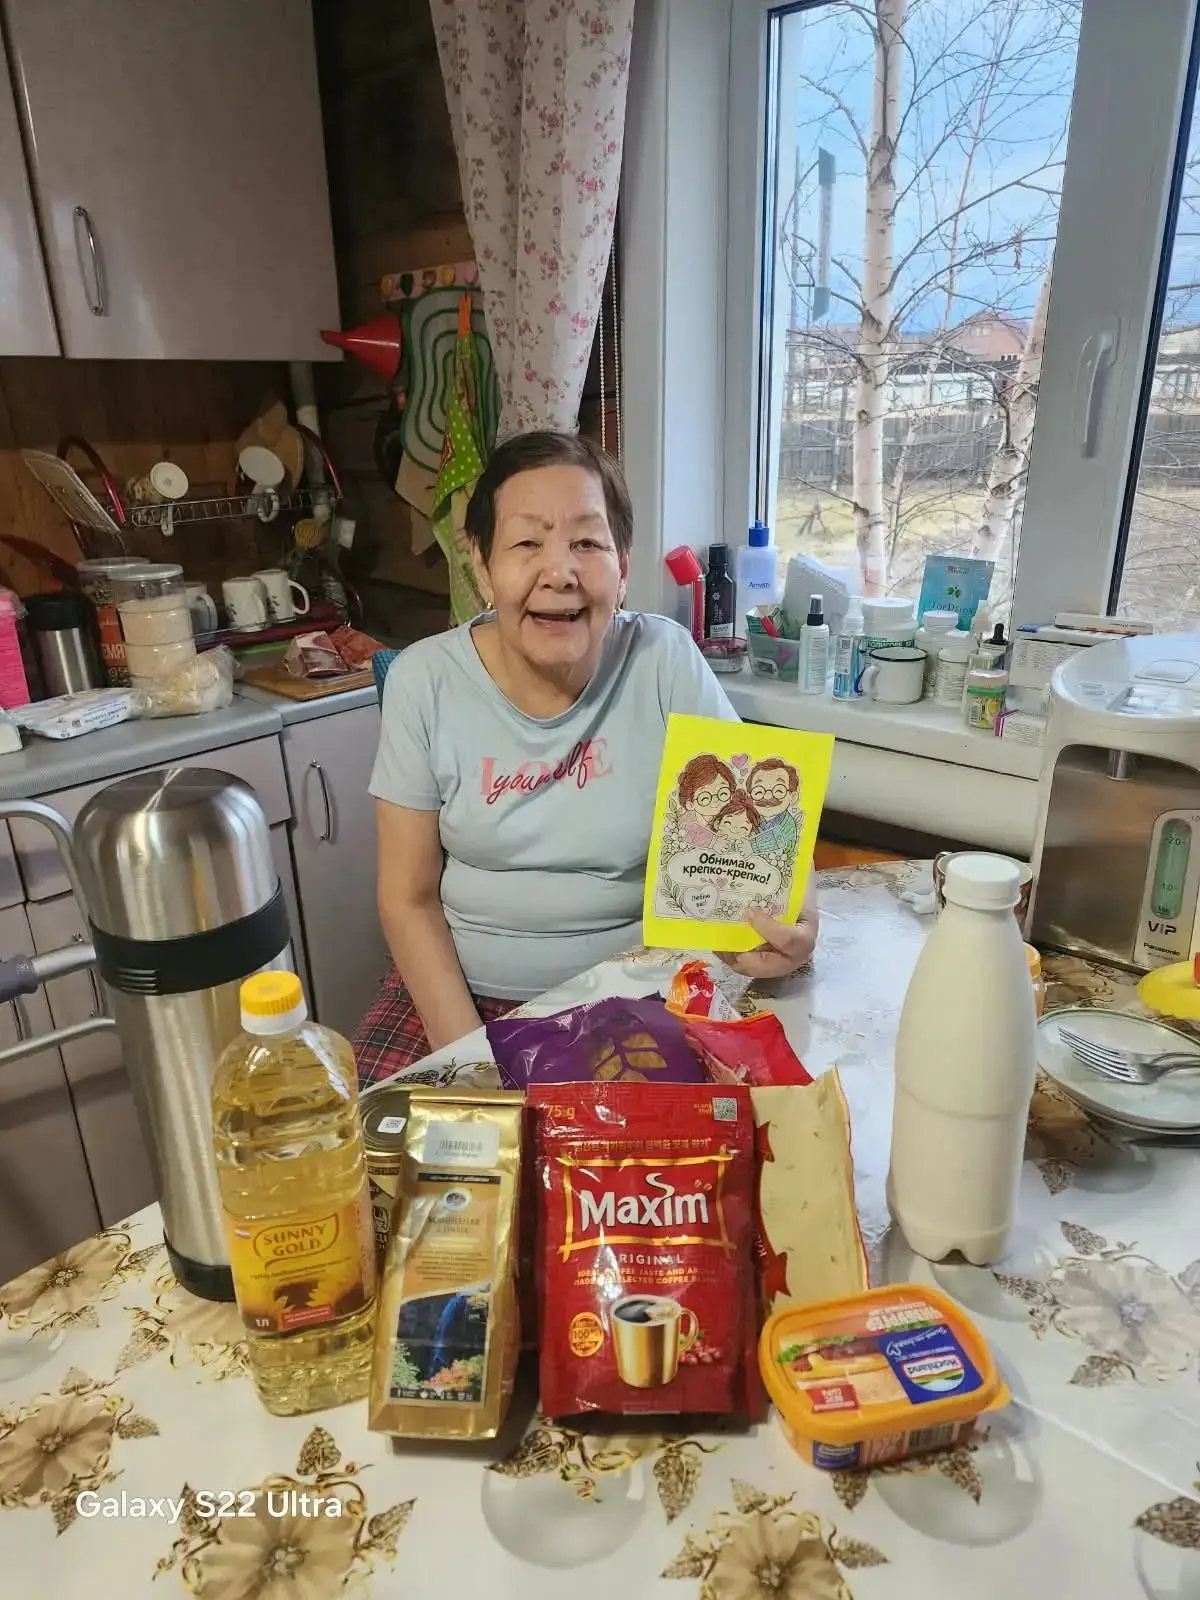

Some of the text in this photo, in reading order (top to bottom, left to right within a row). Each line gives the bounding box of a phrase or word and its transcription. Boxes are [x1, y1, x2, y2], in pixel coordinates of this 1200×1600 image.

[699, 852, 755, 871] Обнимаю
[683, 865, 771, 885] крепко-крепко!
[1143, 942, 1181, 956] Panasonic
[580, 1174, 710, 1232] Maxim
[263, 1223, 327, 1246] SUNNY
[272, 1238, 321, 1257] GOLD
[608, 1252, 685, 1265] RIGINAL
[906, 1358, 958, 1375] Hochland
